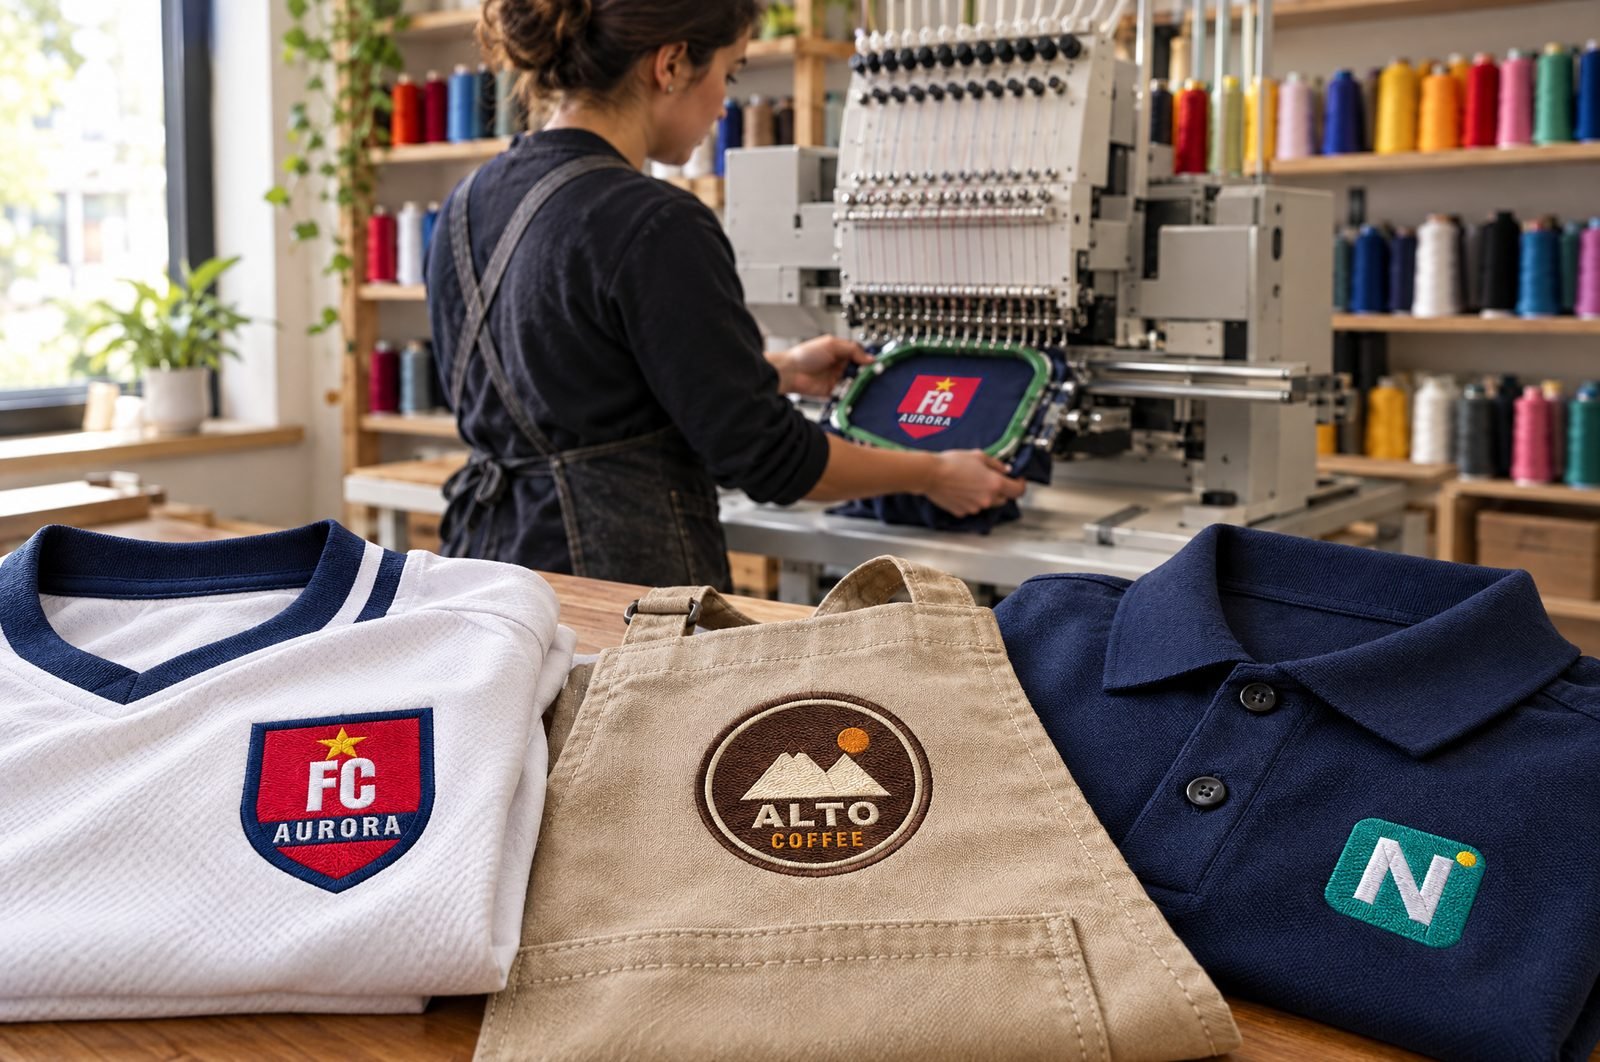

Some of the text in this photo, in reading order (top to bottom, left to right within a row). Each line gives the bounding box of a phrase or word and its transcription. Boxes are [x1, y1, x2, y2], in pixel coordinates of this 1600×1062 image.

[916, 390, 954, 414] FC
[898, 413, 952, 427] AURORA
[306, 758, 376, 812] FC
[751, 801, 880, 829] ALTO
[272, 815, 401, 844] AURORA
[771, 831, 864, 849] COFFEE
[1352, 836, 1455, 927] N
